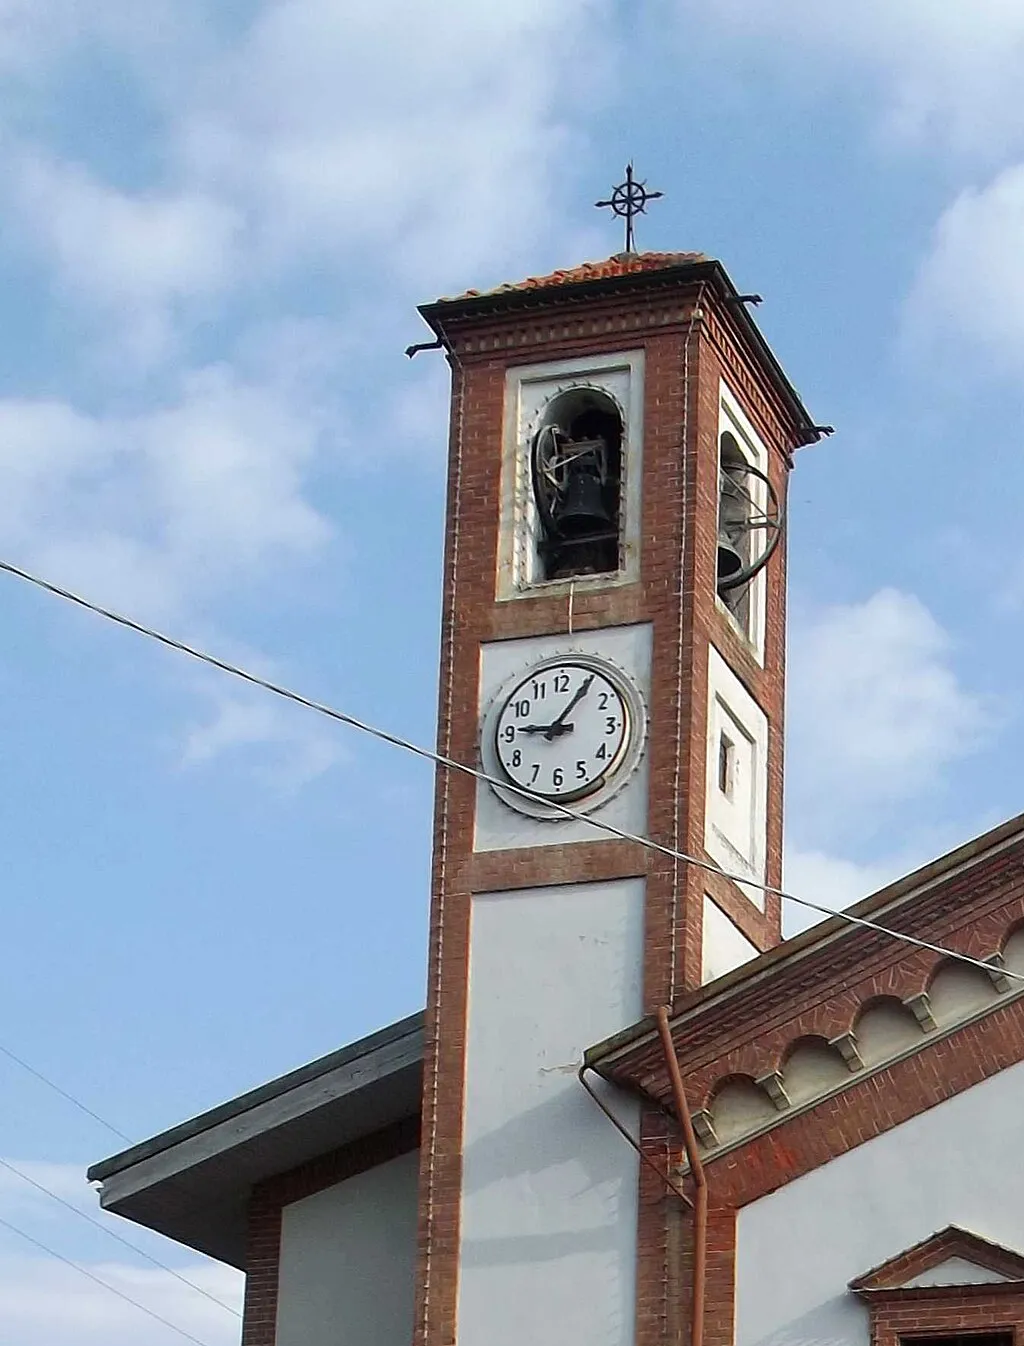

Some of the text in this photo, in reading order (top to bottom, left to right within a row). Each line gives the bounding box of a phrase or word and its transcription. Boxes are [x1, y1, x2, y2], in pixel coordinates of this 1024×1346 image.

[534, 682, 545, 700] 11
[553, 675, 570, 693] 12
[515, 700, 530, 718] 10
[598, 692, 608, 710] 2
[505, 725, 515, 743] 9
[605, 717, 616, 734] 3
[512, 749, 521, 767] 8
[595, 742, 606, 760] 4
[531, 764, 540, 783] 7
[553, 768, 563, 786] 6
[576, 760, 586, 779] 5
